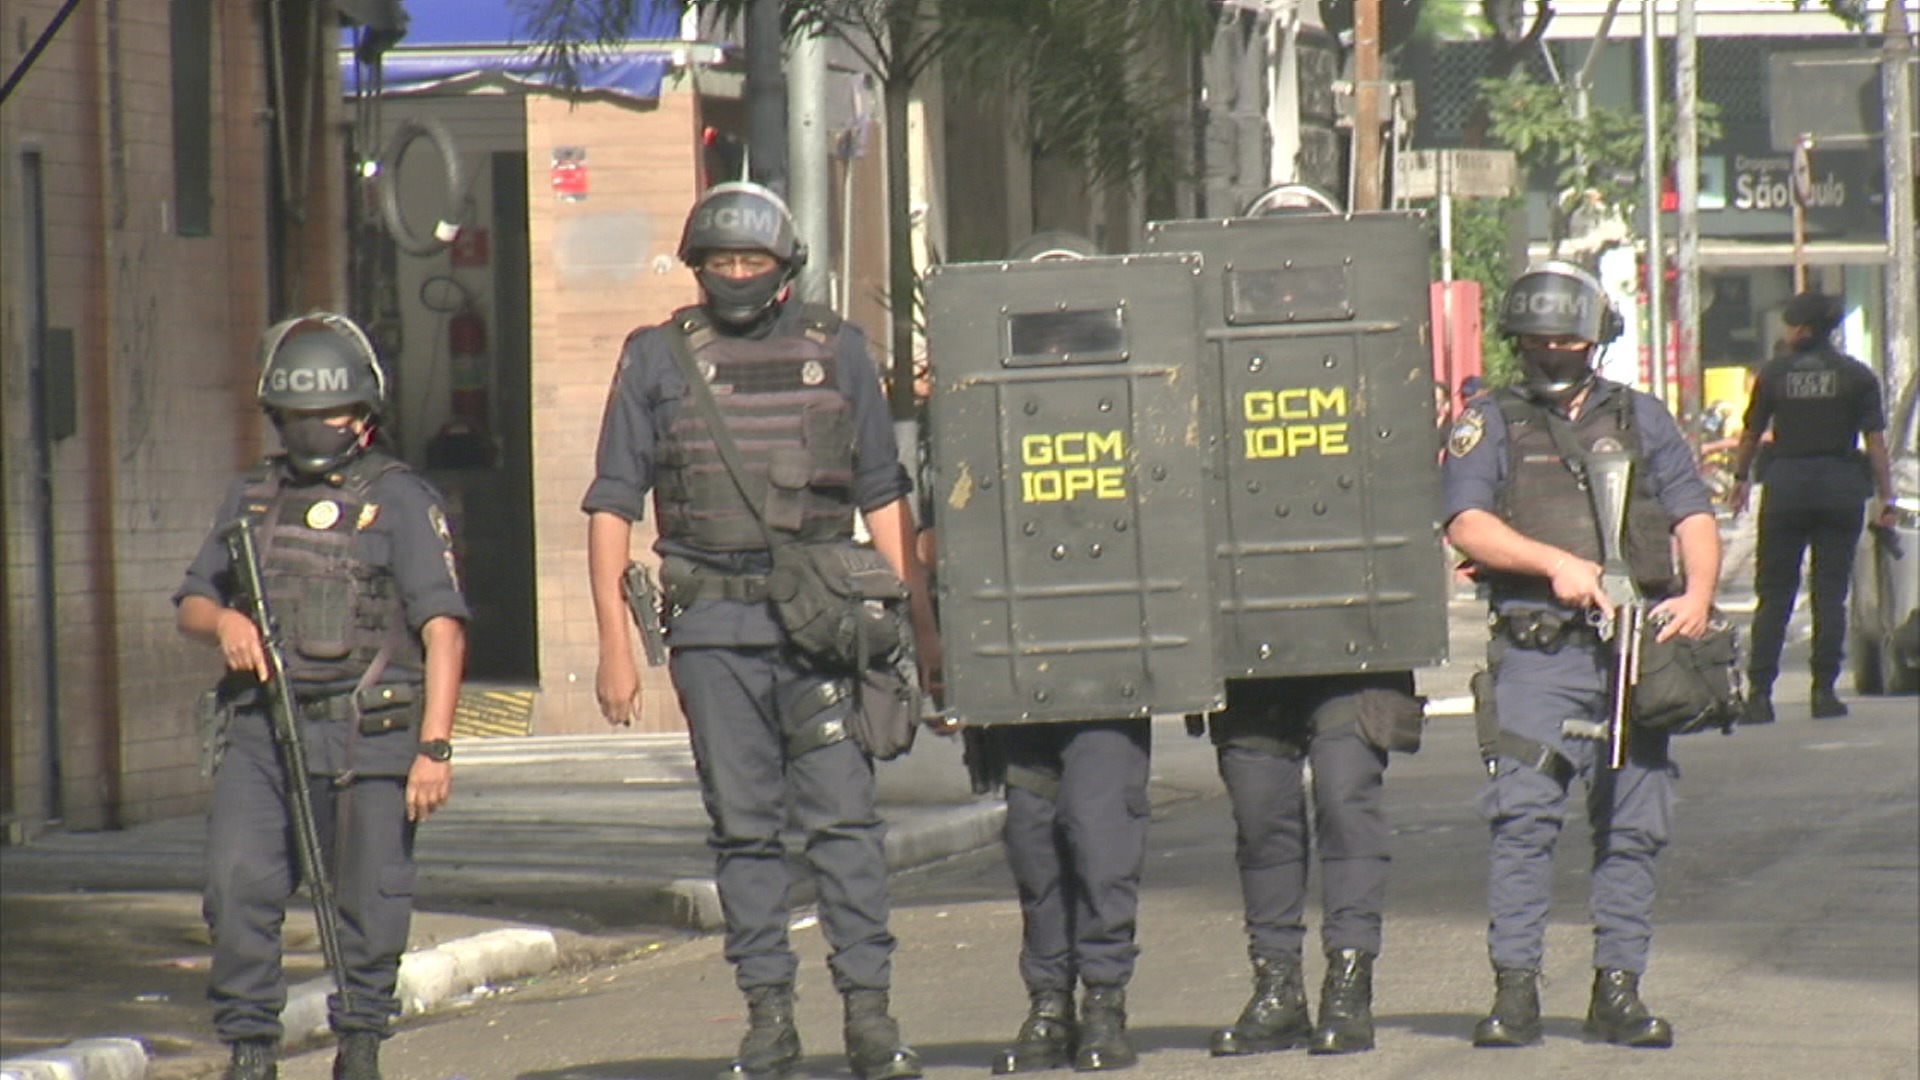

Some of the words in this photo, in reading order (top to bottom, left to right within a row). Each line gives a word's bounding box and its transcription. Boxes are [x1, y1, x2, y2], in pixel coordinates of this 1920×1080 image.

[1735, 174, 1787, 208] São
[695, 207, 773, 232] GCM
[1510, 291, 1588, 319] GCM
[272, 368, 348, 392] GCM
[1244, 386, 1346, 421] GCM
[1022, 430, 1123, 465] GCM
[1244, 423, 1349, 459] IOPE
[1021, 466, 1126, 502] IOPE
